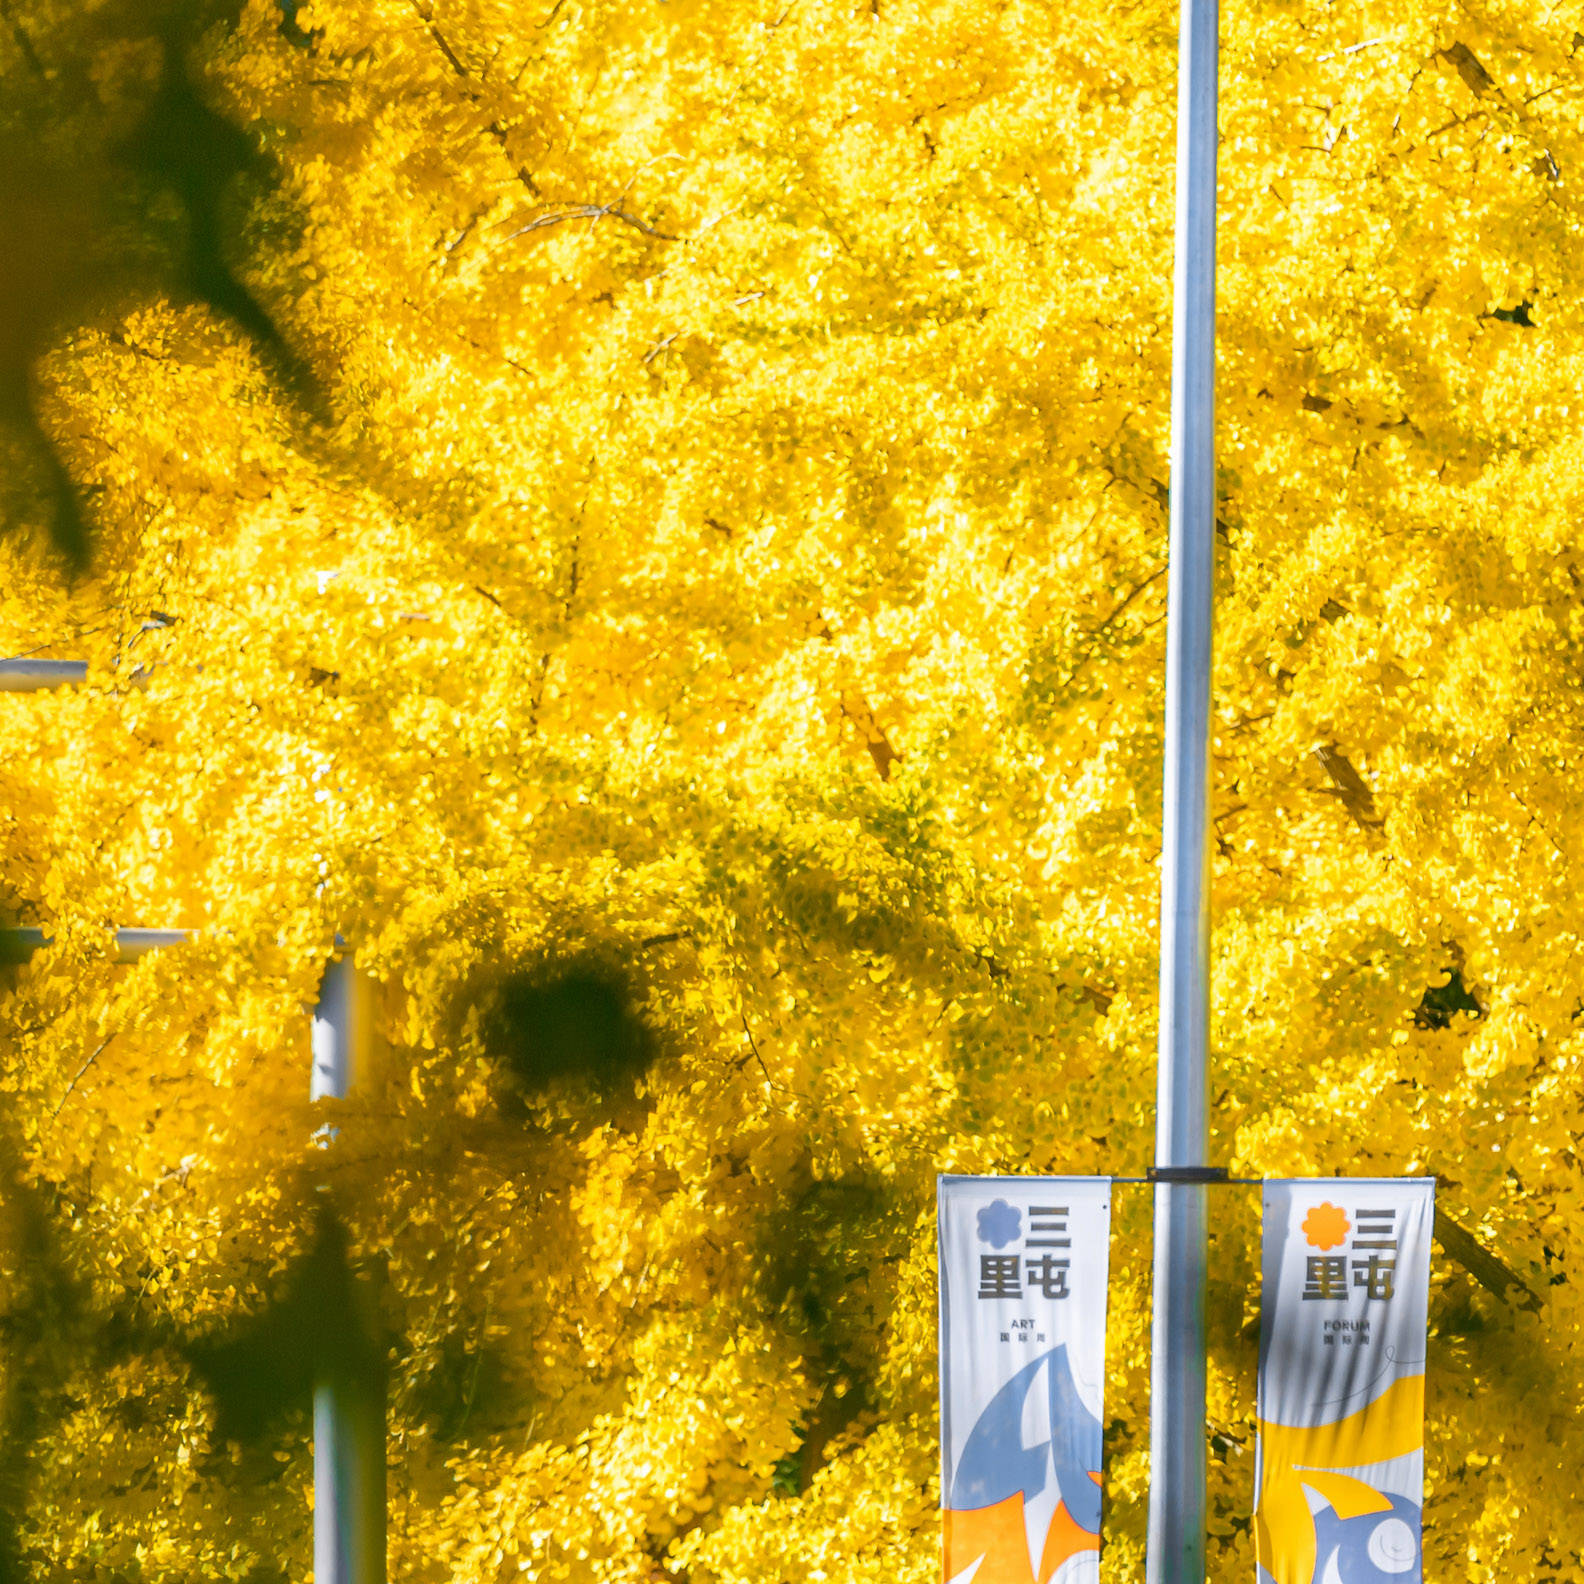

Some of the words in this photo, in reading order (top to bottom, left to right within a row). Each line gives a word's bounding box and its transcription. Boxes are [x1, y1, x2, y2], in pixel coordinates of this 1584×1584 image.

[1026, 1206, 1071, 1248] 三
[1352, 1208, 1397, 1250] 三
[978, 1254, 1071, 1299] 里屯
[1302, 1255, 1396, 1300] 里屯
[1011, 1319, 1036, 1329] ART
[1324, 1321, 1370, 1331] FORUM
